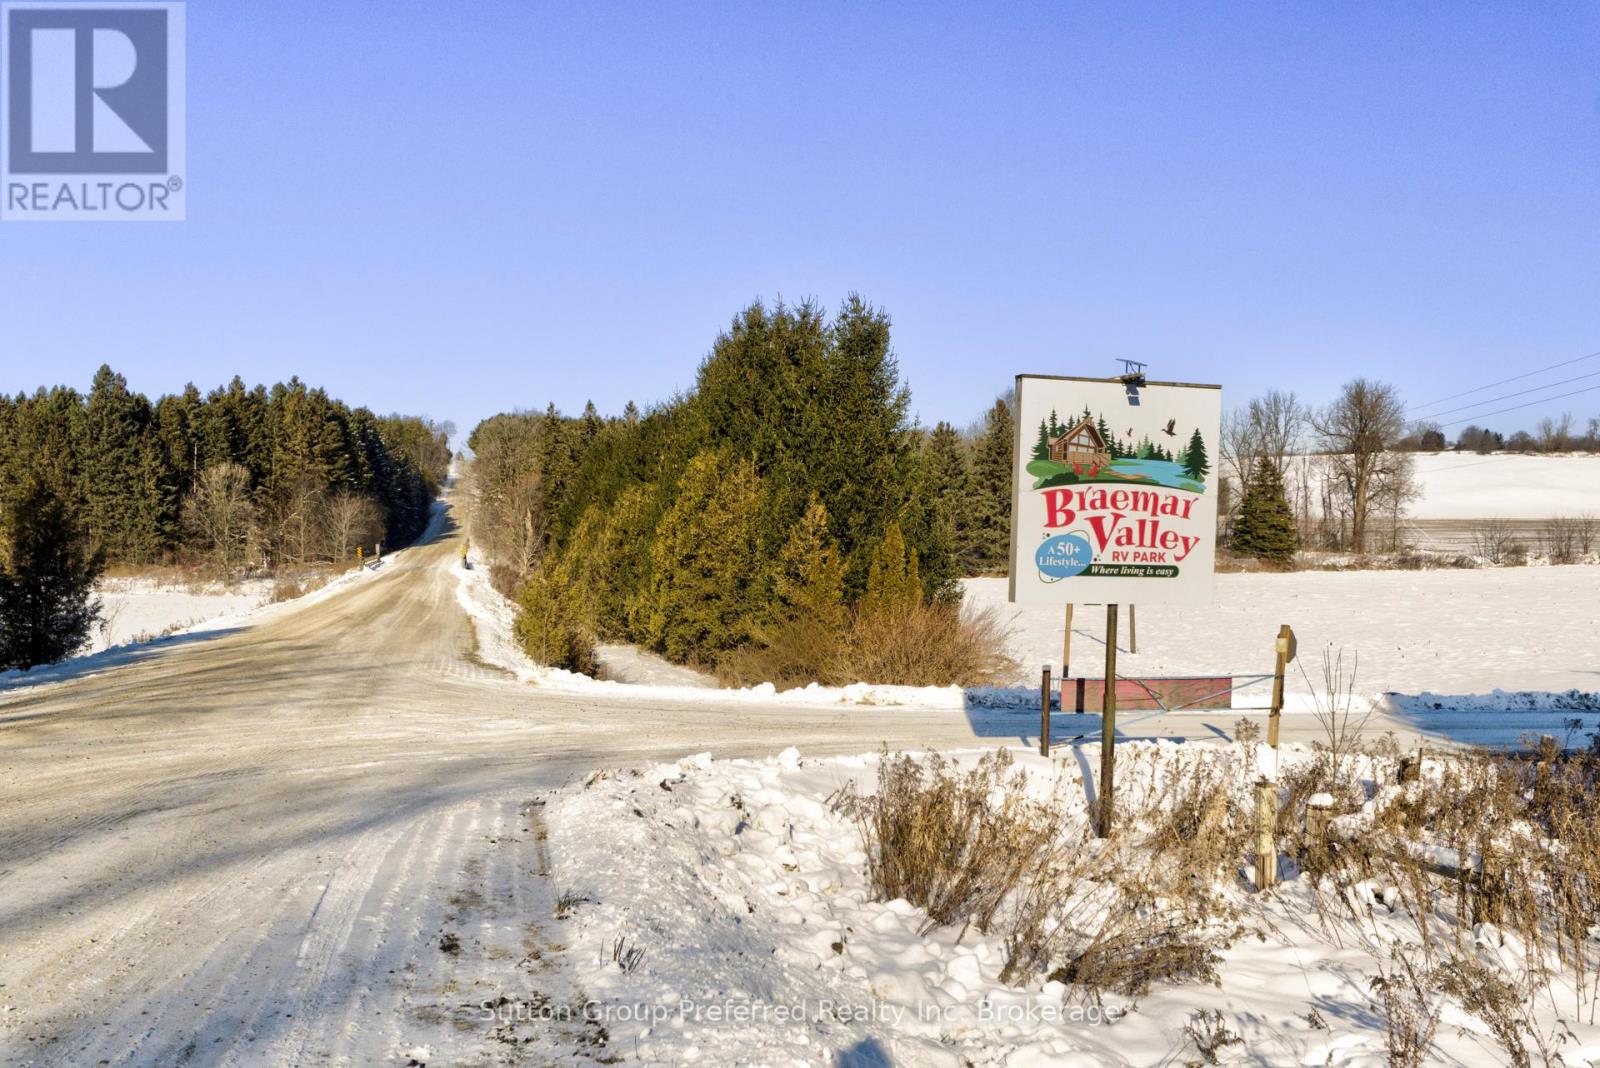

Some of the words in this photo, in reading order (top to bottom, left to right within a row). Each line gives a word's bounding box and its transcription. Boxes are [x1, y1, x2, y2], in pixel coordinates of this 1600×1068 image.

[1041, 486, 1199, 528] Braemar
[1084, 512, 1201, 562] Valley
[1047, 547, 1055, 555] A
[1057, 542, 1081, 556] 50+
[1112, 551, 1130, 562] RV
[1133, 551, 1166, 563] PARK
[1091, 565, 1119, 575] Where
[1120, 566, 1144, 576] living
[1146, 566, 1154, 575] is
[1155, 568, 1174, 577] easy
